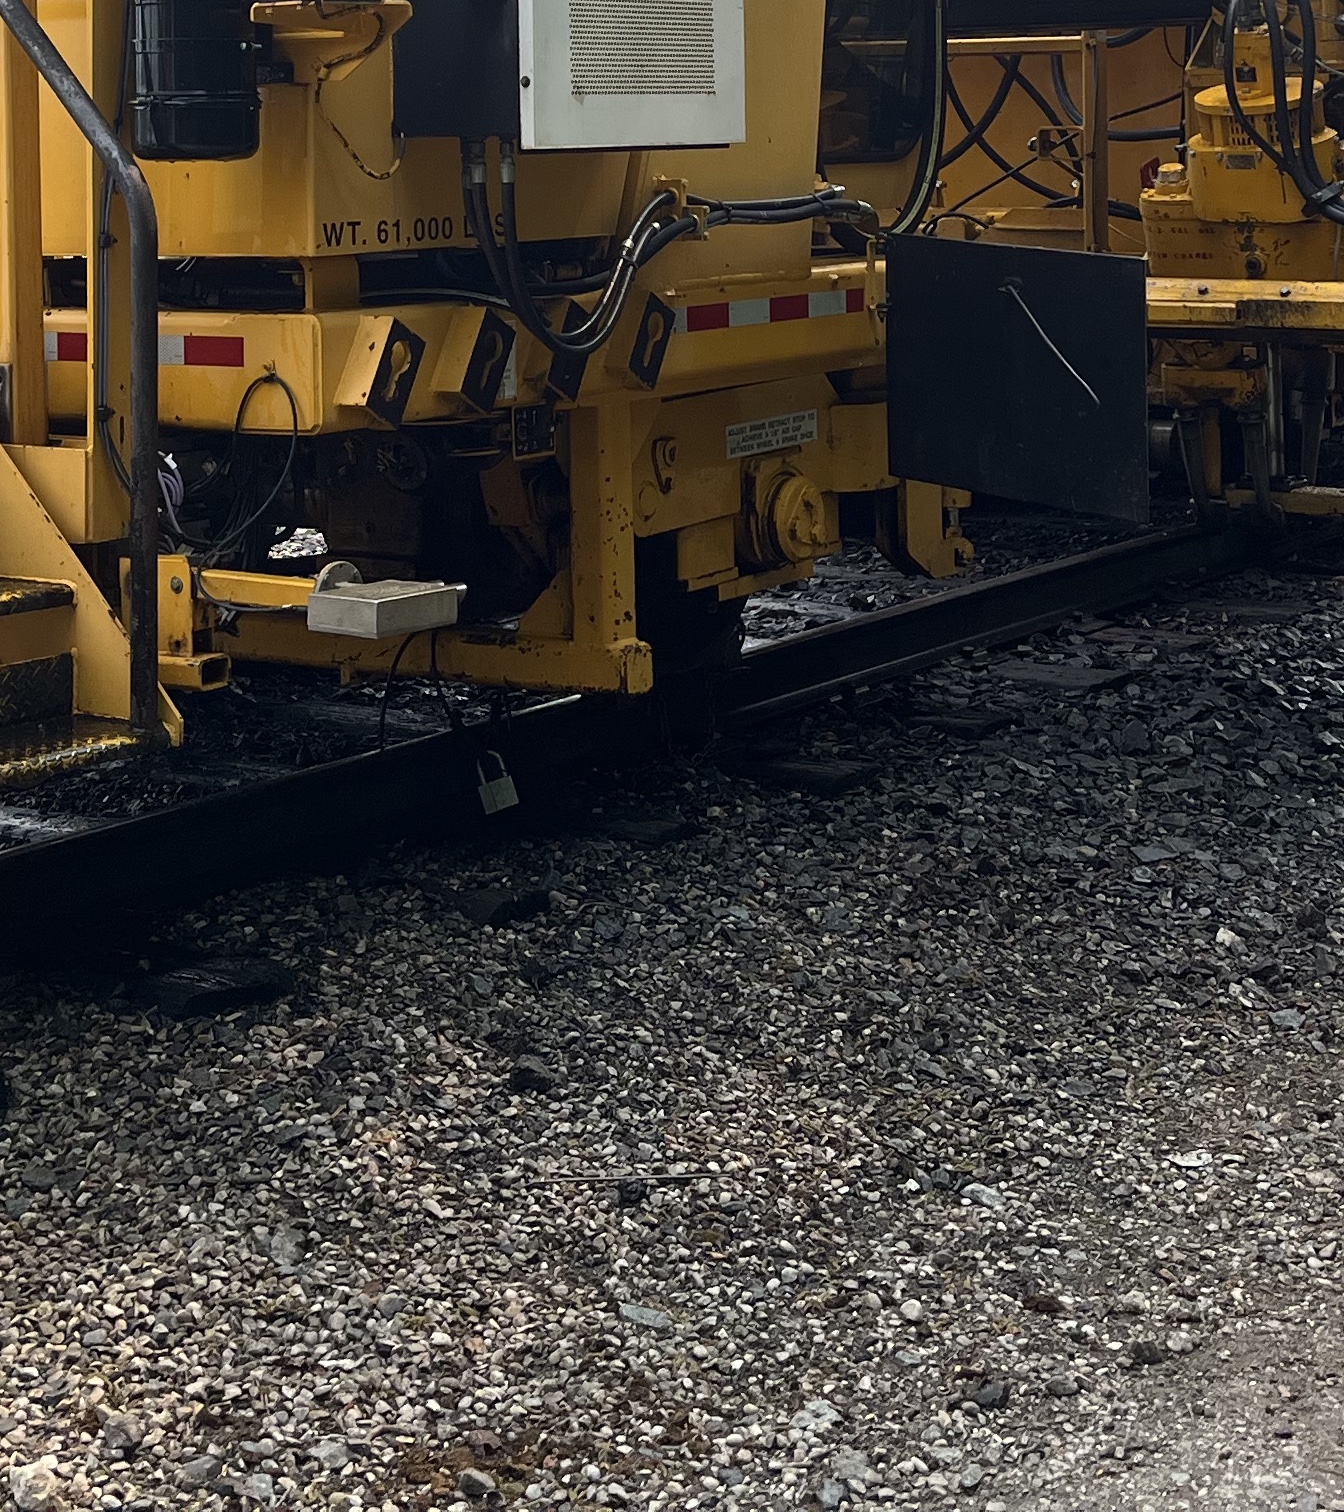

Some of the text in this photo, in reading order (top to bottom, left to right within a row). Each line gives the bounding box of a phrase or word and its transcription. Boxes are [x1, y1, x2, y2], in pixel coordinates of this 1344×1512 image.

[322, 212, 505, 247] WT. 61,000 LS
